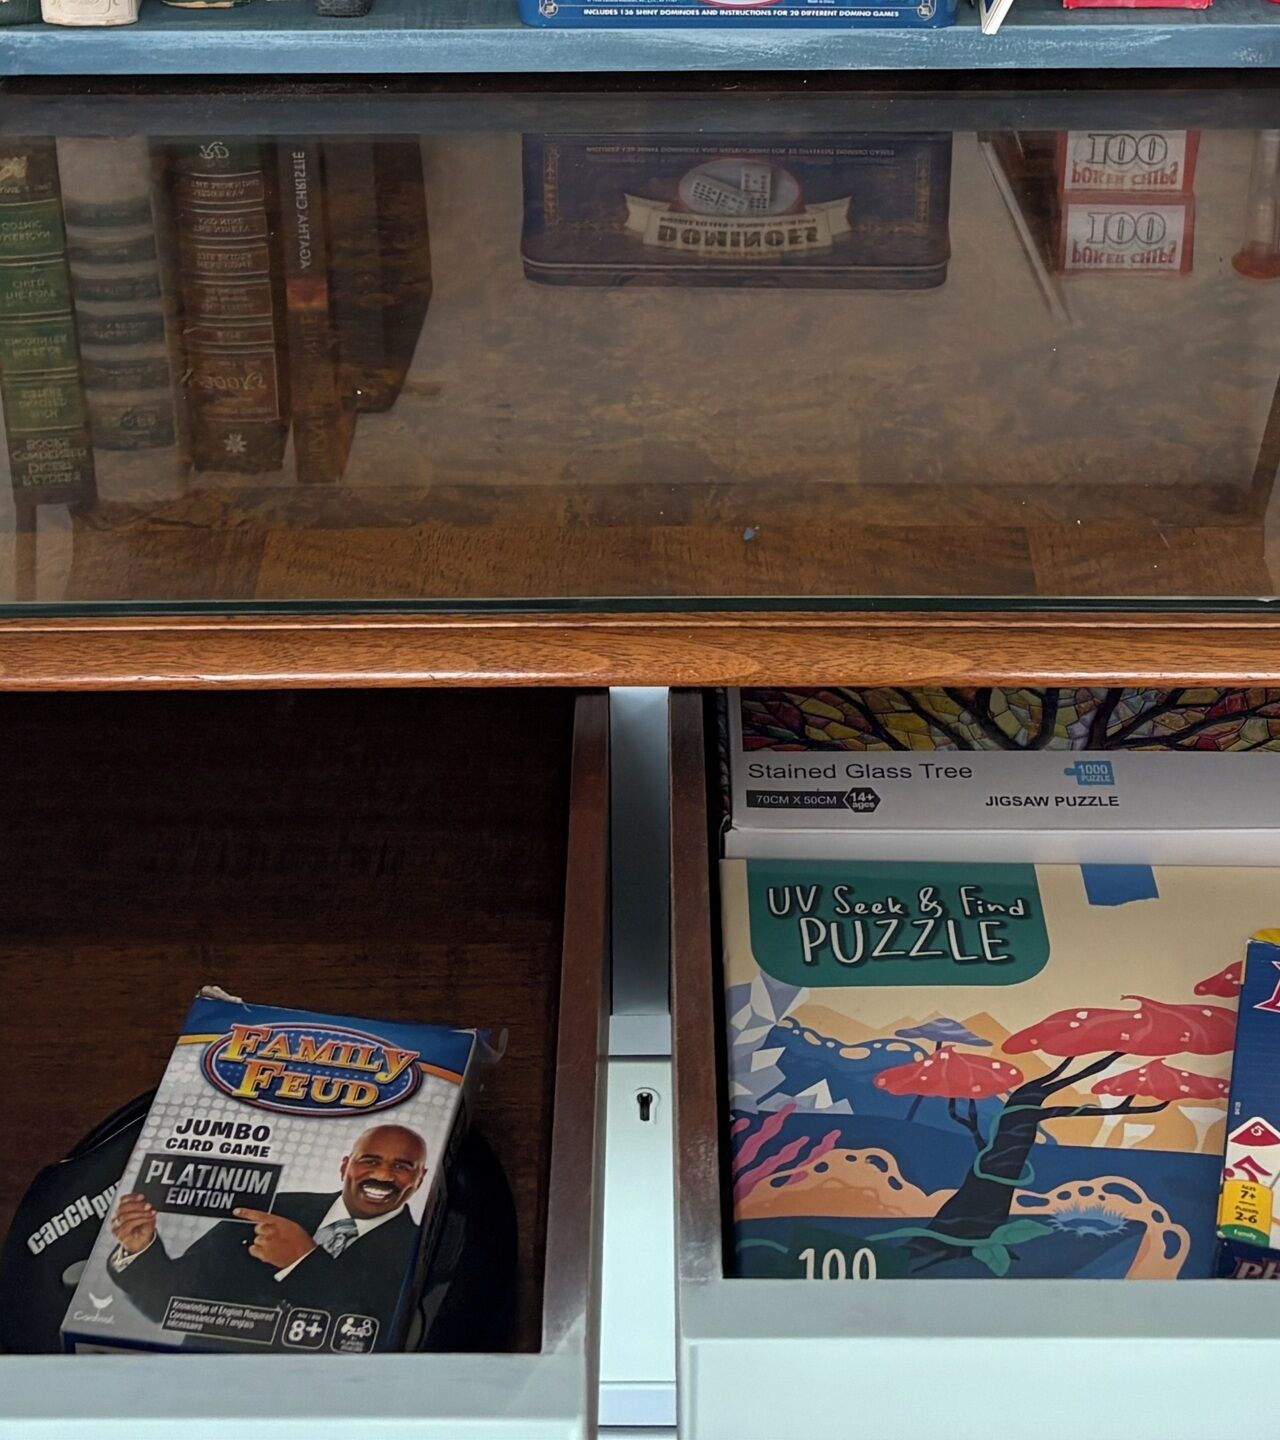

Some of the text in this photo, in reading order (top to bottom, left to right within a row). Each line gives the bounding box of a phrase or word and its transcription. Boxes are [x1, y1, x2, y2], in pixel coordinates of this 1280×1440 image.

[748, 763, 973, 780] Stained Glass Tree
[1078, 764, 1108, 776] 1000
[1081, 774, 1111, 782] PUZZLE
[985, 796, 1120, 807] JIGSAW PUZZLE
[768, 885, 1025, 917] UV Seek & Find
[799, 917, 1008, 964] PUZZLE
[220, 1023, 420, 1083] FAMILY
[231, 1059, 378, 1108] FEUD
[176, 1118, 271, 1142] JUMBO
[165, 1138, 271, 1158] CARD GAME
[145, 1160, 272, 1195] PLATINUM
[166, 1185, 234, 1209] EDITION
[798, 1248, 877, 1280] 100
[289, 1320, 322, 1341] 8+
